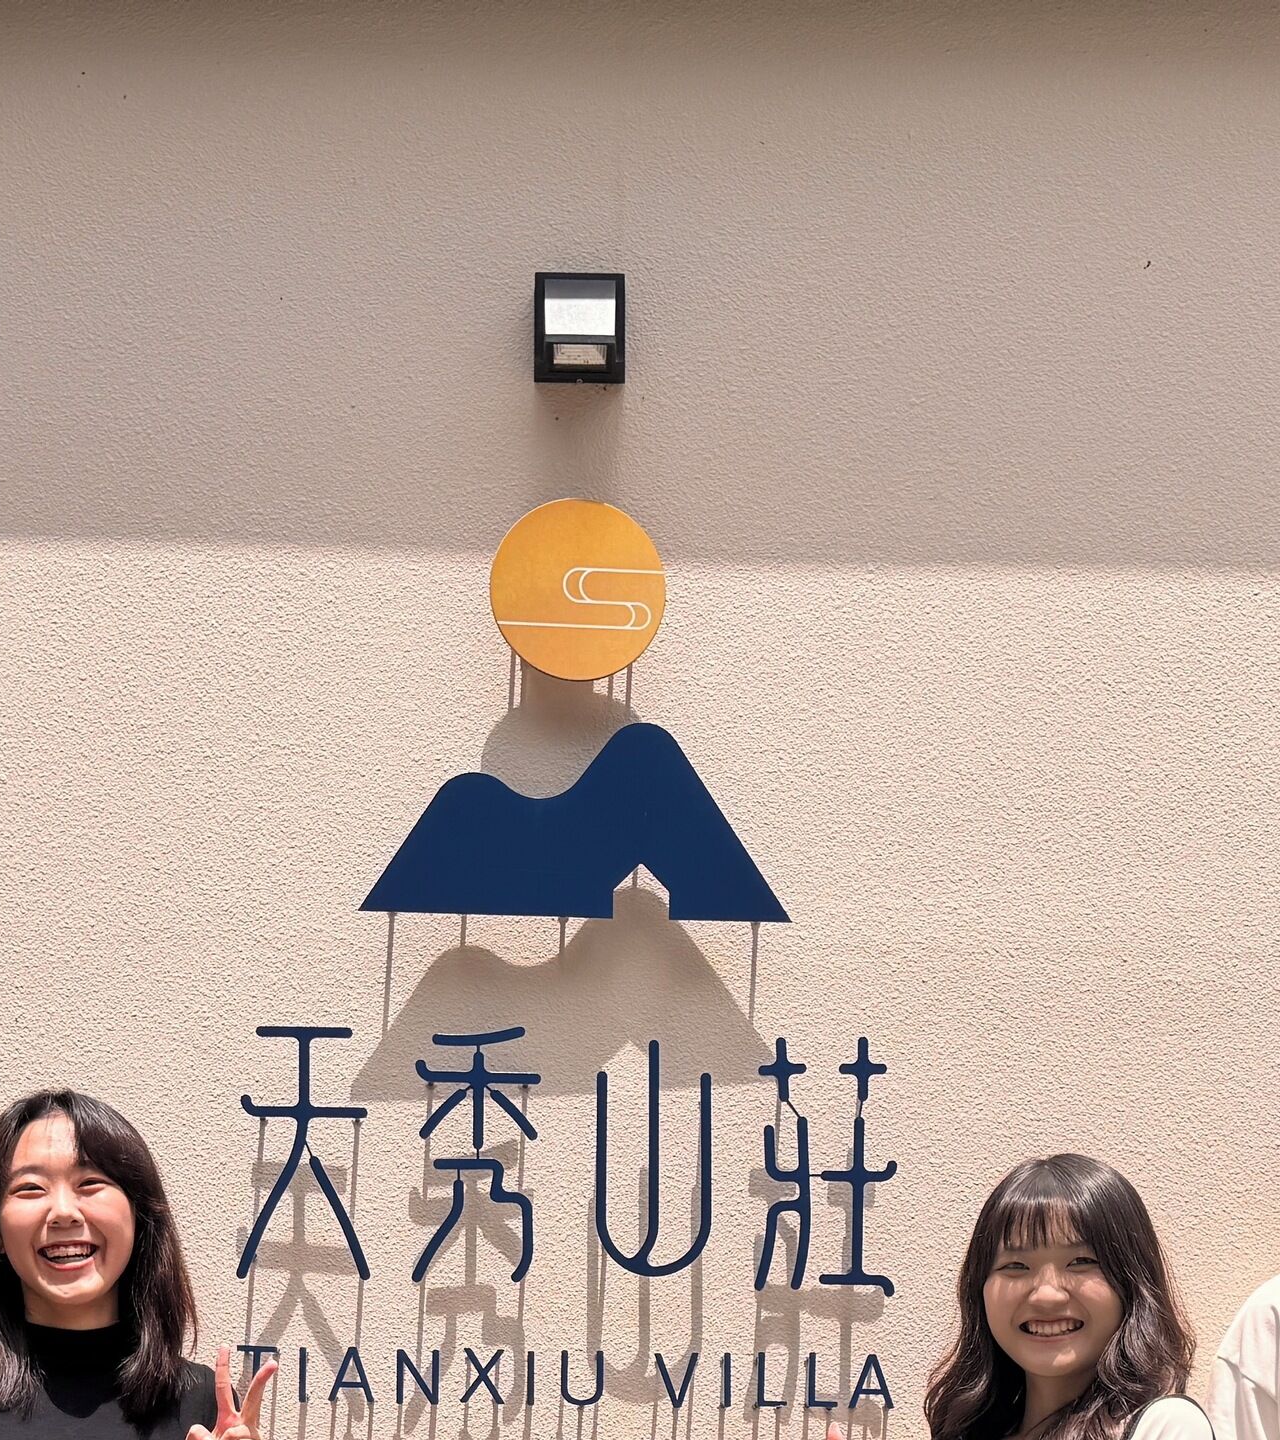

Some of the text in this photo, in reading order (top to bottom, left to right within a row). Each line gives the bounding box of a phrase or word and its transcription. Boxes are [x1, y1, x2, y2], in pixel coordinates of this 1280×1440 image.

[236, 1026, 898, 1297] 天秀山莊
[236, 1345, 894, 1409] TIANXIU VILLA
